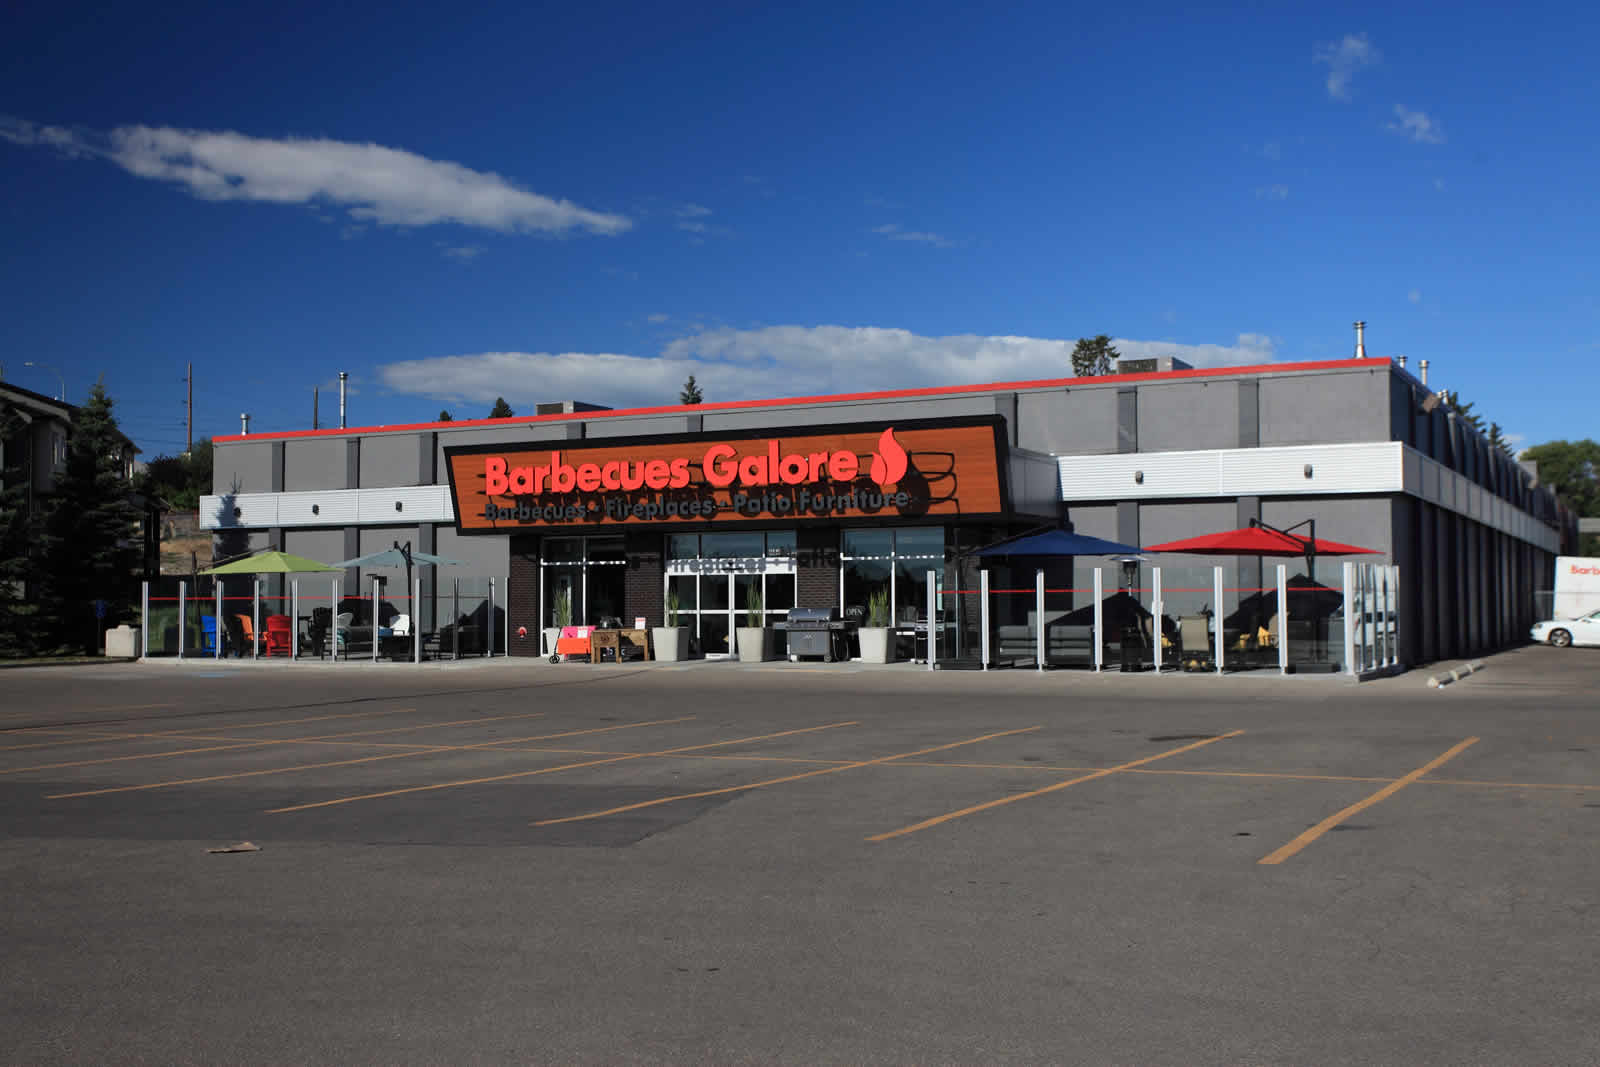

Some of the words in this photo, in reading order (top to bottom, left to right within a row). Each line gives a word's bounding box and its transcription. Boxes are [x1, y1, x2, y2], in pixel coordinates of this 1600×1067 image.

[485, 451, 690, 495] Barbecues
[702, 440, 859, 487] Galore
[485, 500, 586, 521] Barbecues
[606, 495, 712, 520] Fireplaces
[733, 491, 791, 513] Patio
[799, 488, 909, 512] Furniture
[846, 608, 863, 616] OPEN
